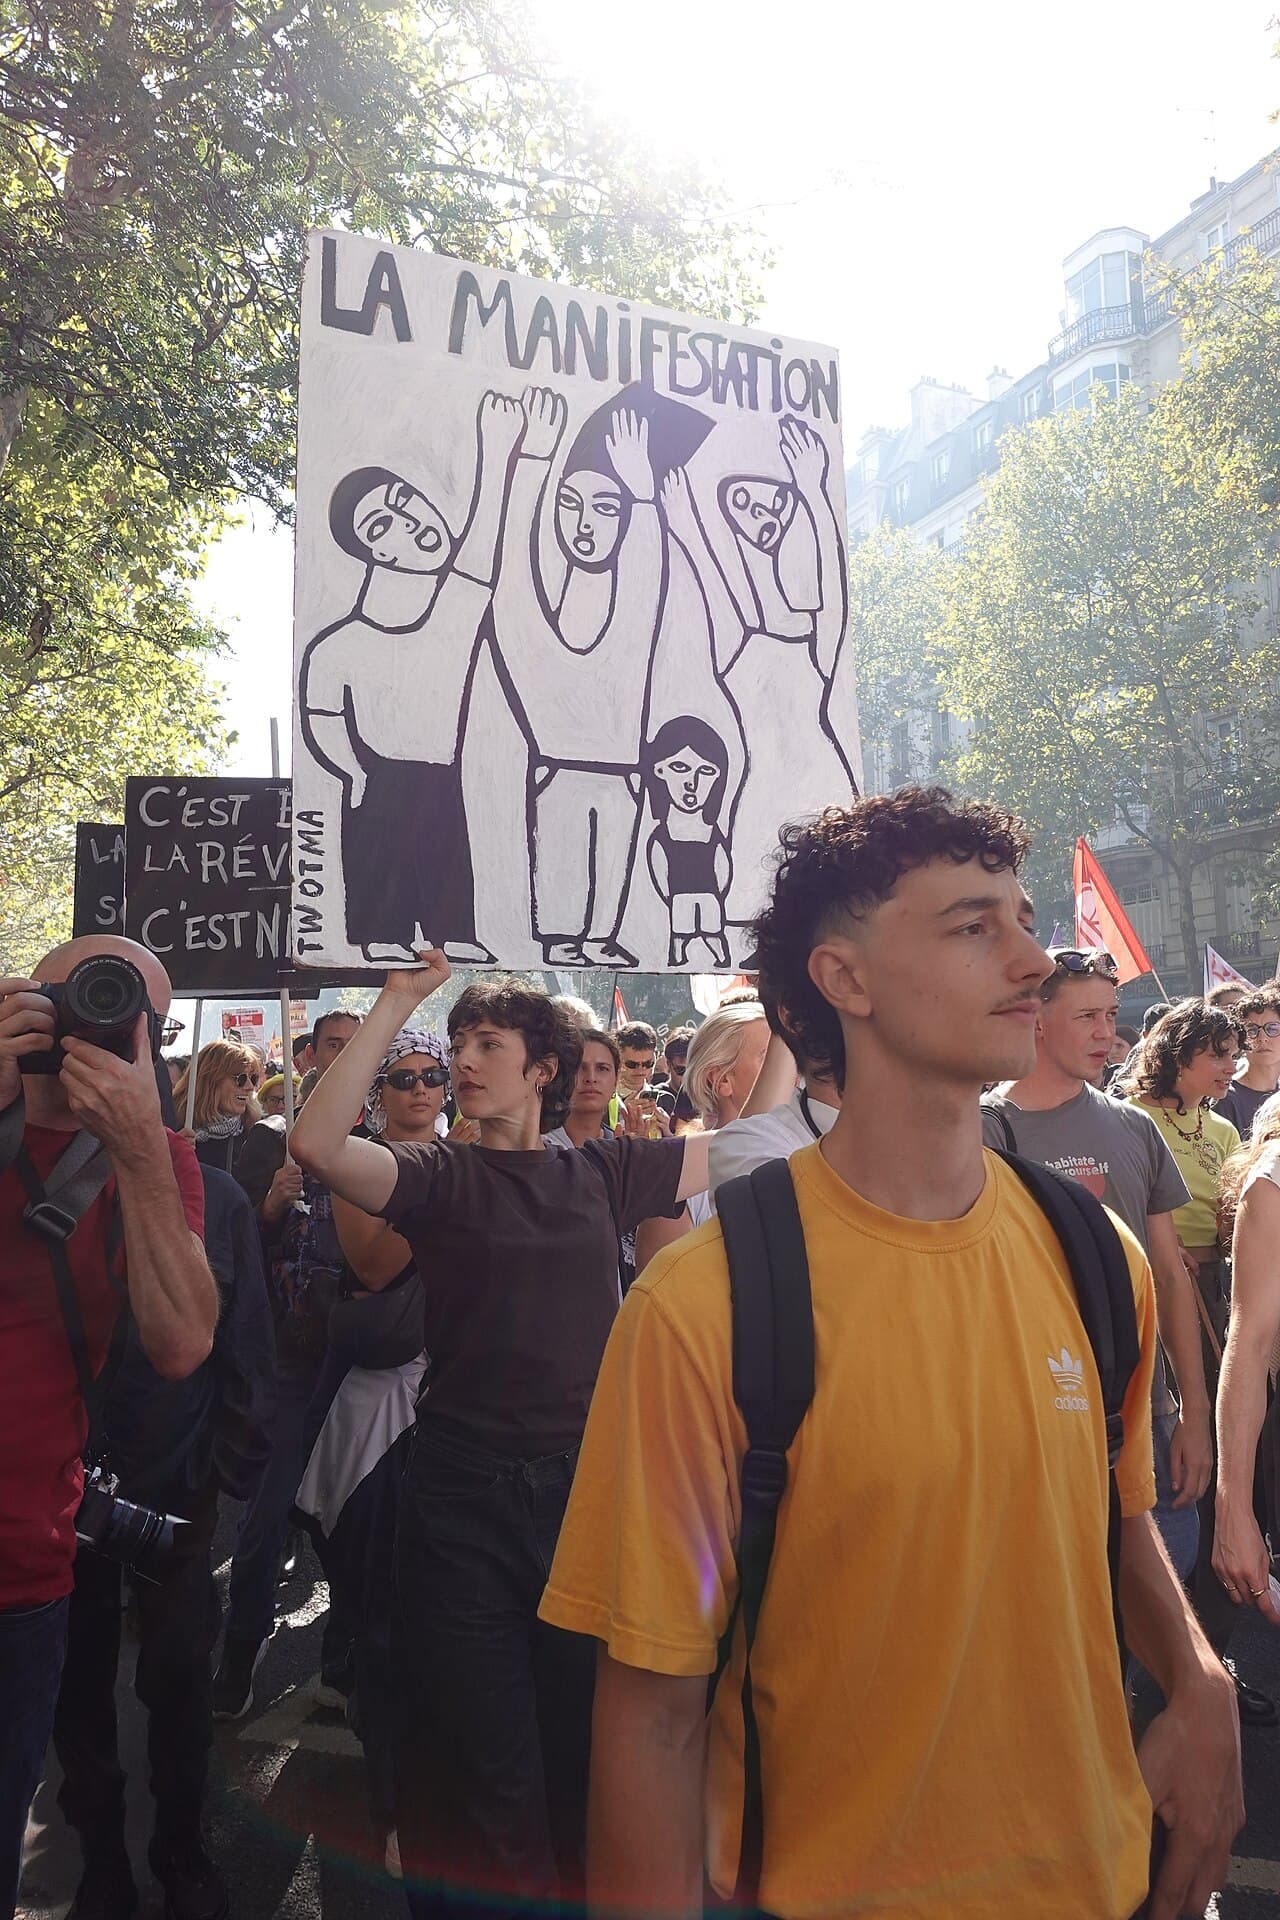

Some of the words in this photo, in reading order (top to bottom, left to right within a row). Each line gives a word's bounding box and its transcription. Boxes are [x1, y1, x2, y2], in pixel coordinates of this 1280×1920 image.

[320, 236, 412, 343] LA
[138, 785, 251, 829] C'EST
[195, 833, 291, 884] RÉV
[293, 810, 326, 956] TWOTMA
[141, 900, 251, 953] C'EST
[1055, 1394, 1089, 1411] adidas
